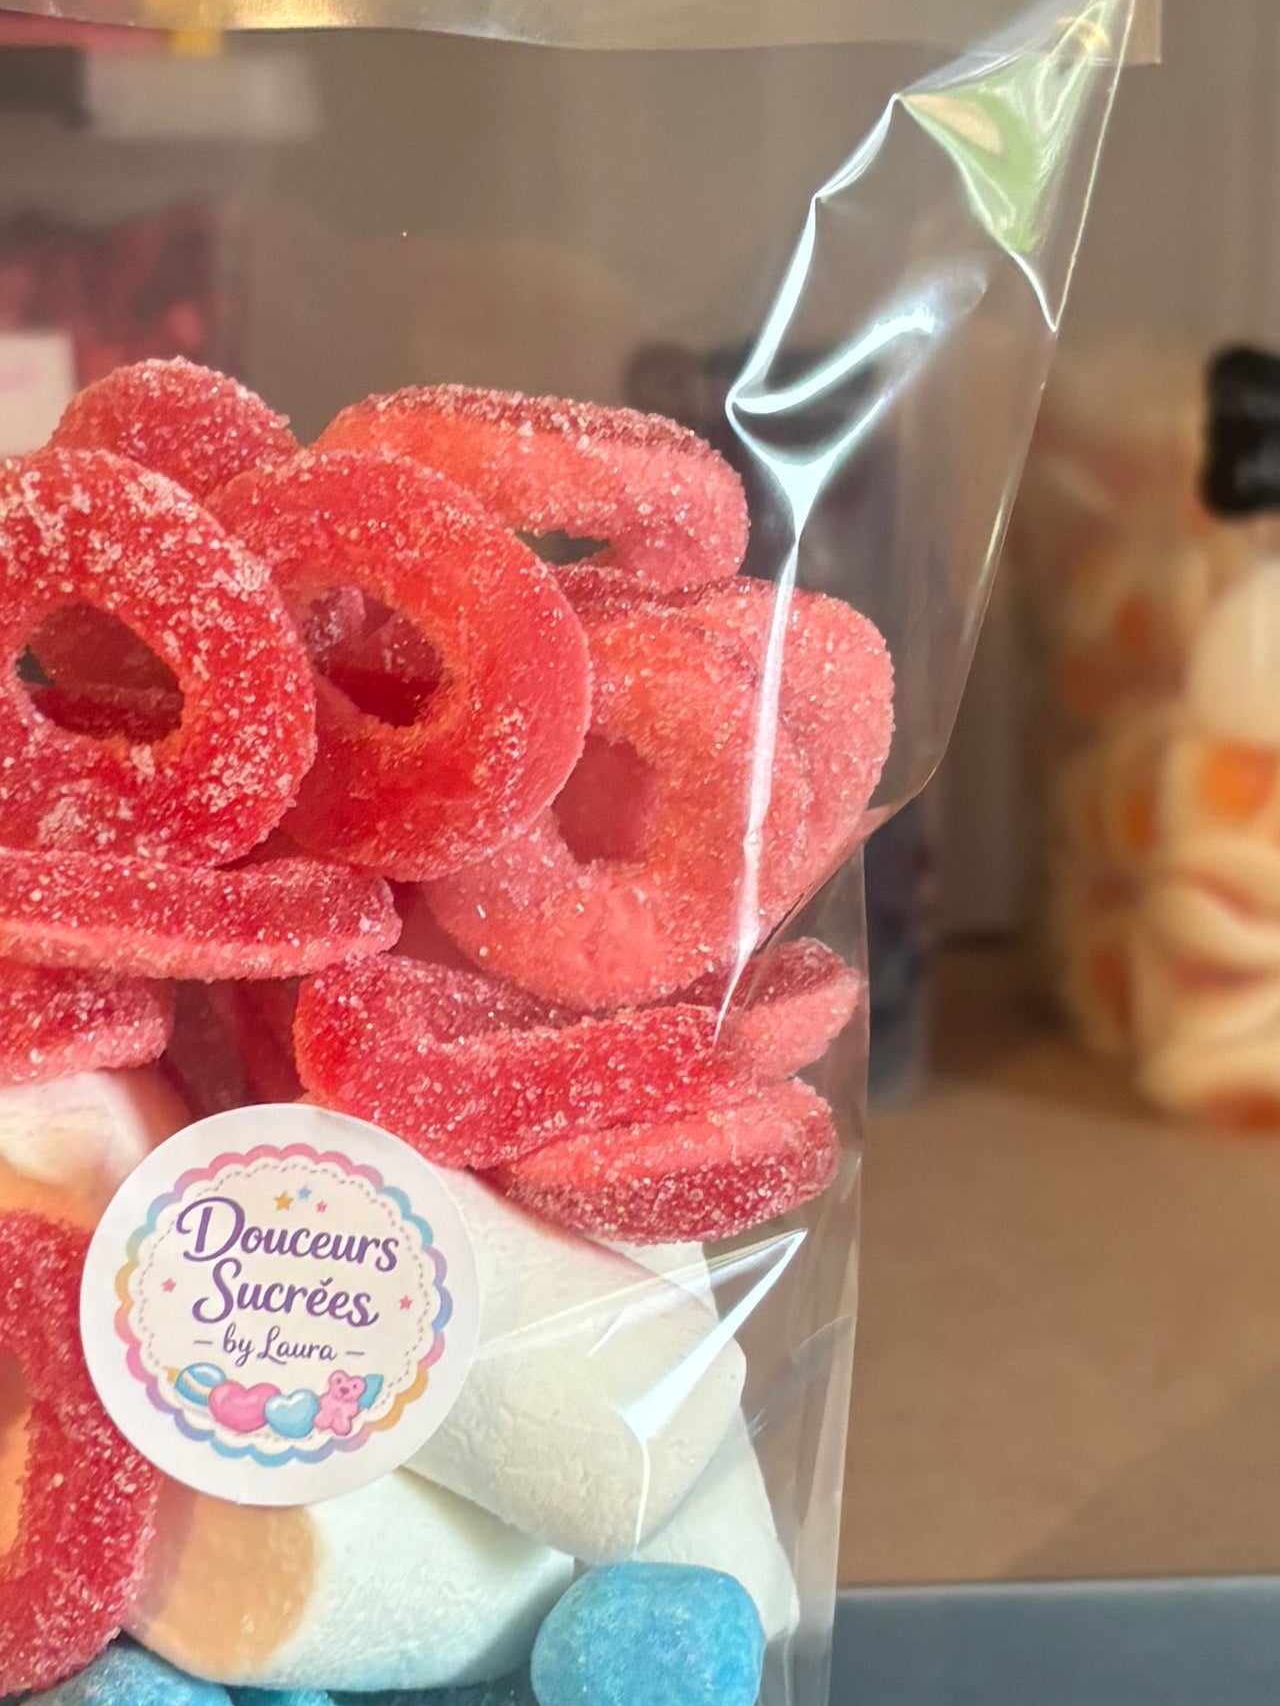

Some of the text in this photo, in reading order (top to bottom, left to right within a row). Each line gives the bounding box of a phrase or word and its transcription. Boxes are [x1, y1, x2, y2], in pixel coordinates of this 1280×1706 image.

[175, 1195, 400, 1273] Douceurs
[191, 1256, 380, 1328] Sucrées
[222, 1322, 337, 1367] by Laura
